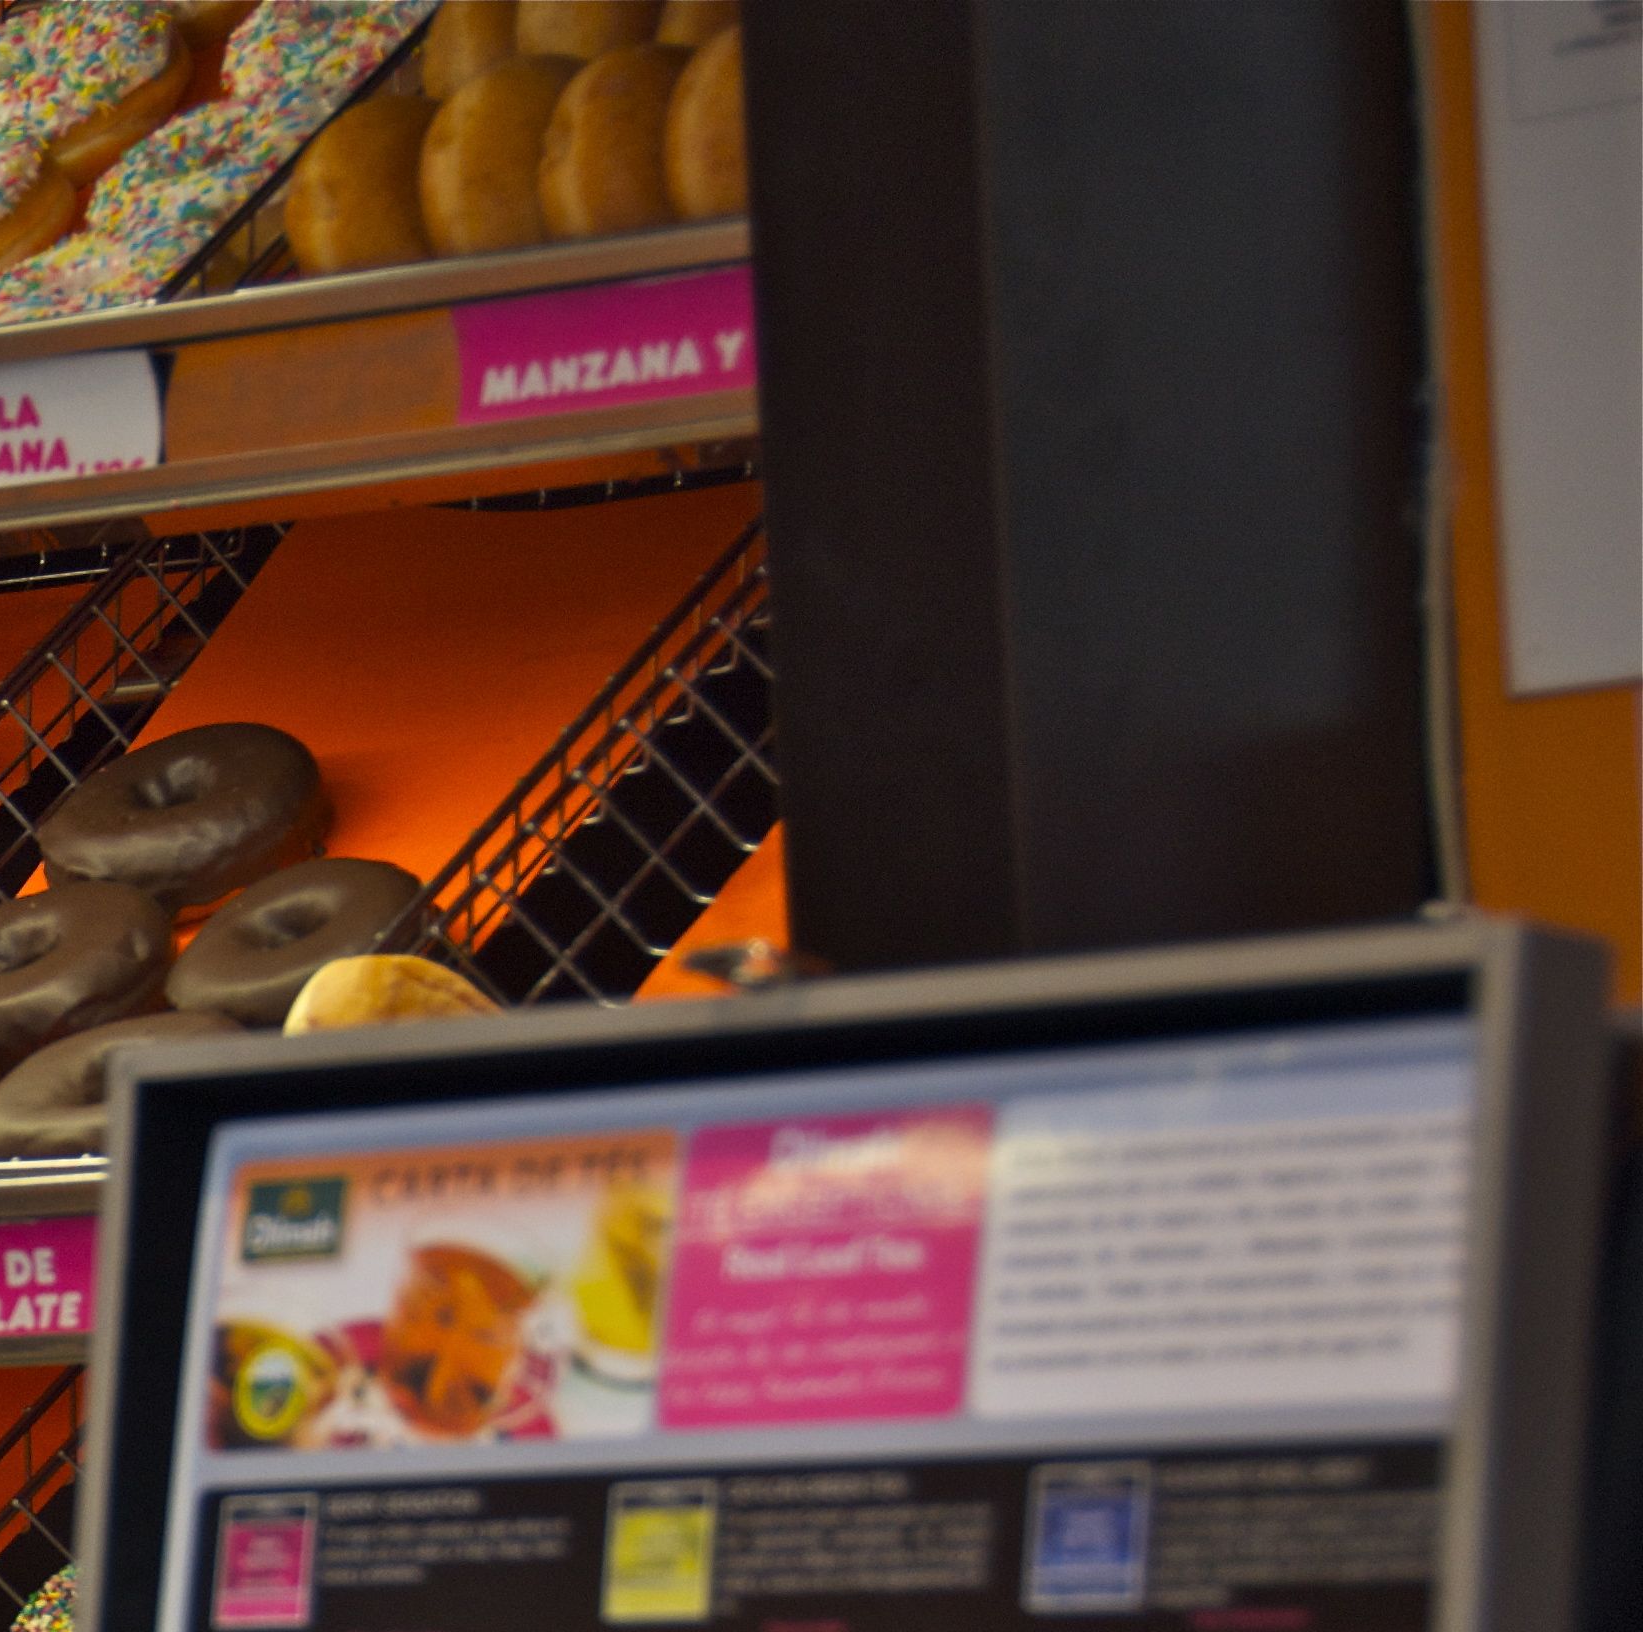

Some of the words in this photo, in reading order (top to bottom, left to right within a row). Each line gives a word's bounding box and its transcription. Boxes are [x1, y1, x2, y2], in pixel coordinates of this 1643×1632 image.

[480, 336, 702, 407] MANZANA
[716, 328, 745, 373] Y
[4, 1247, 56, 1288] DE
